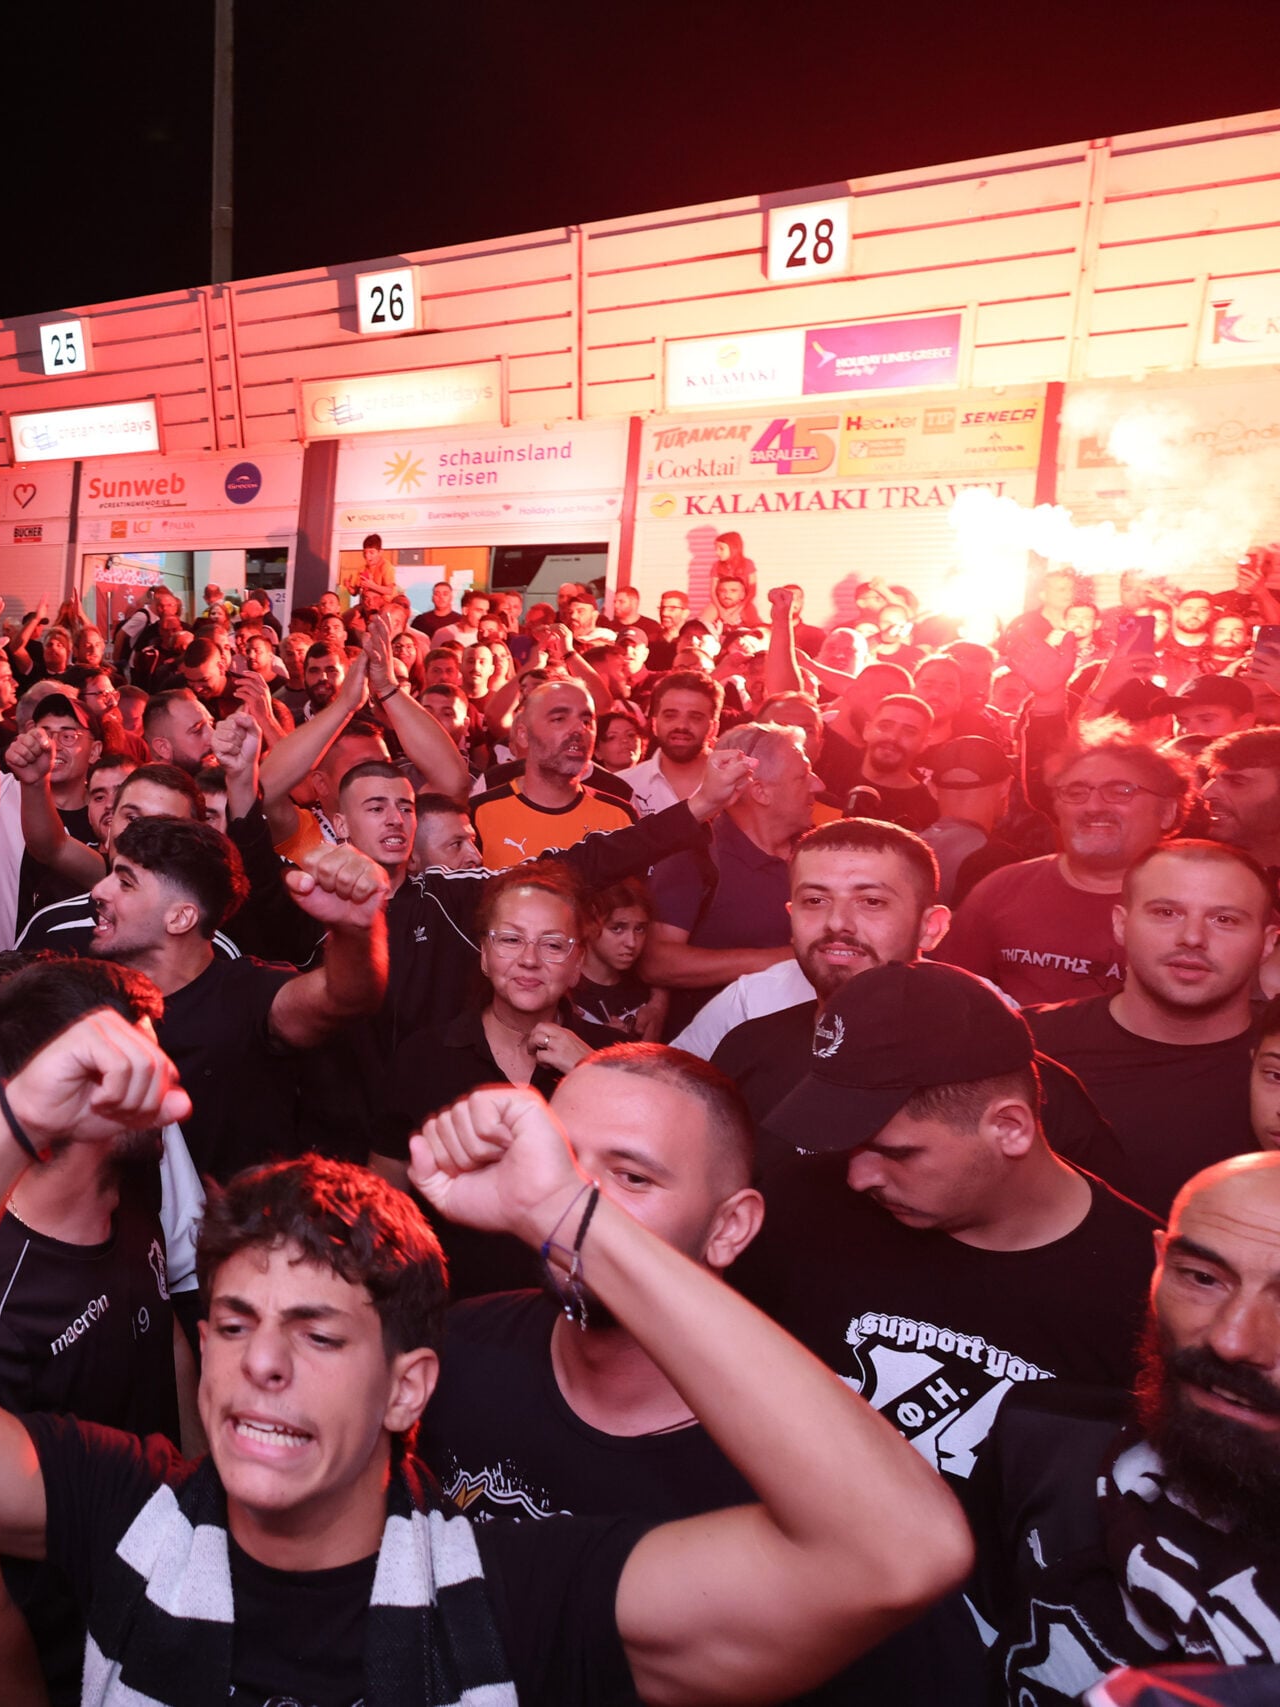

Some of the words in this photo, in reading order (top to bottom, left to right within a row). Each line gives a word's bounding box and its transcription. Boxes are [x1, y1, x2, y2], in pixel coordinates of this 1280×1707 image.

[785, 217, 835, 268] 28
[370, 283, 405, 324] 26
[51, 332, 77, 366] 25
[835, 354, 882, 369] HOLIDAY
[882, 351, 911, 365] LINES
[911, 346, 952, 361] GREECE
[686, 368, 777, 388] KALAMAKI
[926, 413, 954, 426] TIP
[960, 408, 1037, 425] SENECA
[653, 425, 753, 452] TURANCAR
[750, 415, 840, 475] 45
[439, 441, 572, 467] schauinsland
[750, 447, 819, 462] PARALELA
[87, 472, 186, 499] Sunweb
[437, 468, 498, 487] reisen
[427, 509, 470, 521] Eurowings
[518, 505, 556, 517] Holidays
[683, 488, 871, 516] KALAMAKI
[13, 526, 43, 538] BUCHER
[50, 1294, 110, 1356] macron
[859, 1313, 983, 1364] support
